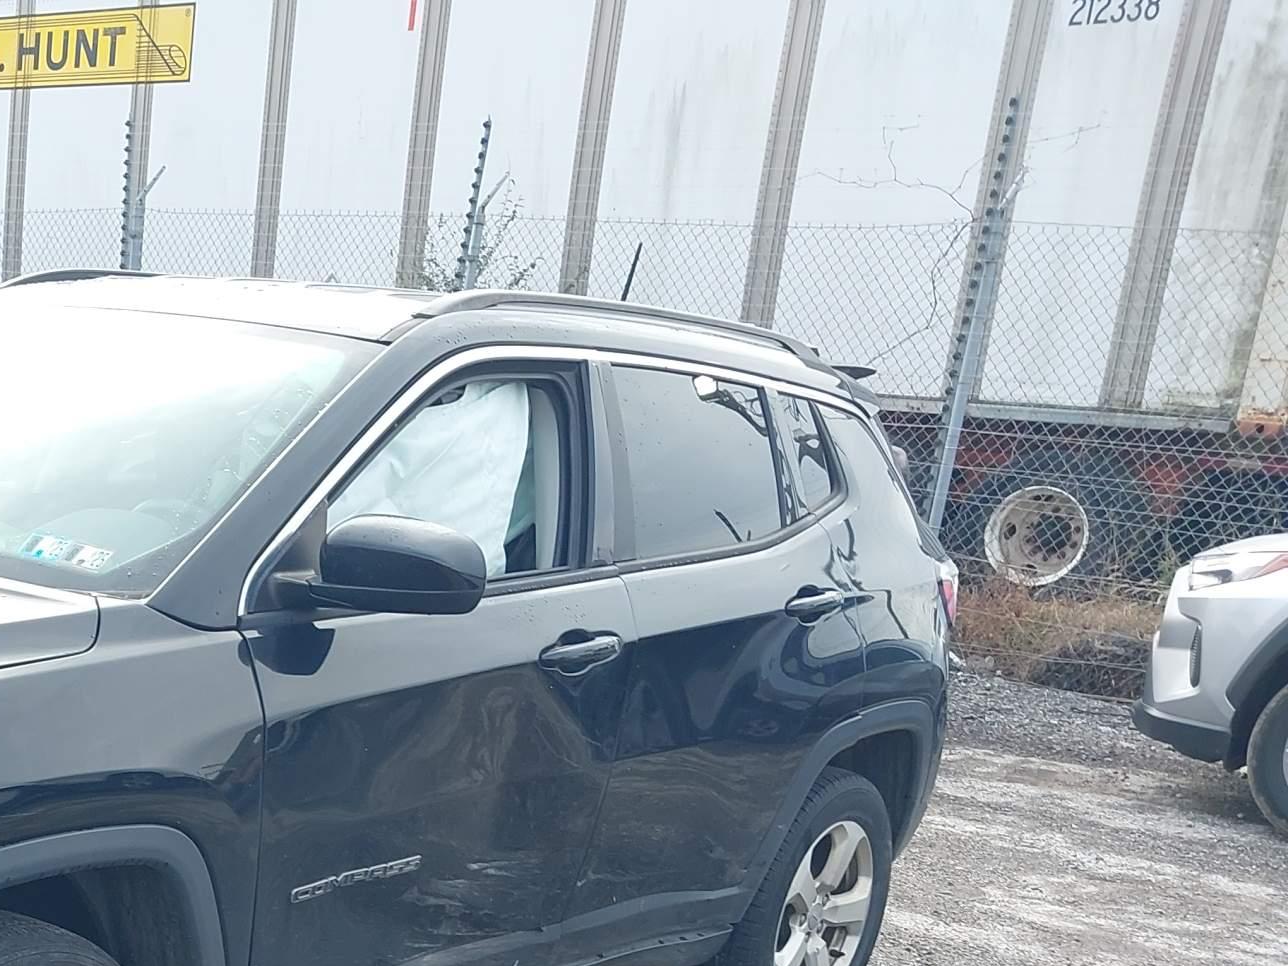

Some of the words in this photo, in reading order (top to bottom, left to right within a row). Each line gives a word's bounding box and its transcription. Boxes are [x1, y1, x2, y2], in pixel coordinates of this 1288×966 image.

[1068, 0, 1161, 26] 212338
[17, 27, 126, 72] HUNT
[290, 854, 423, 904] COMPASS
